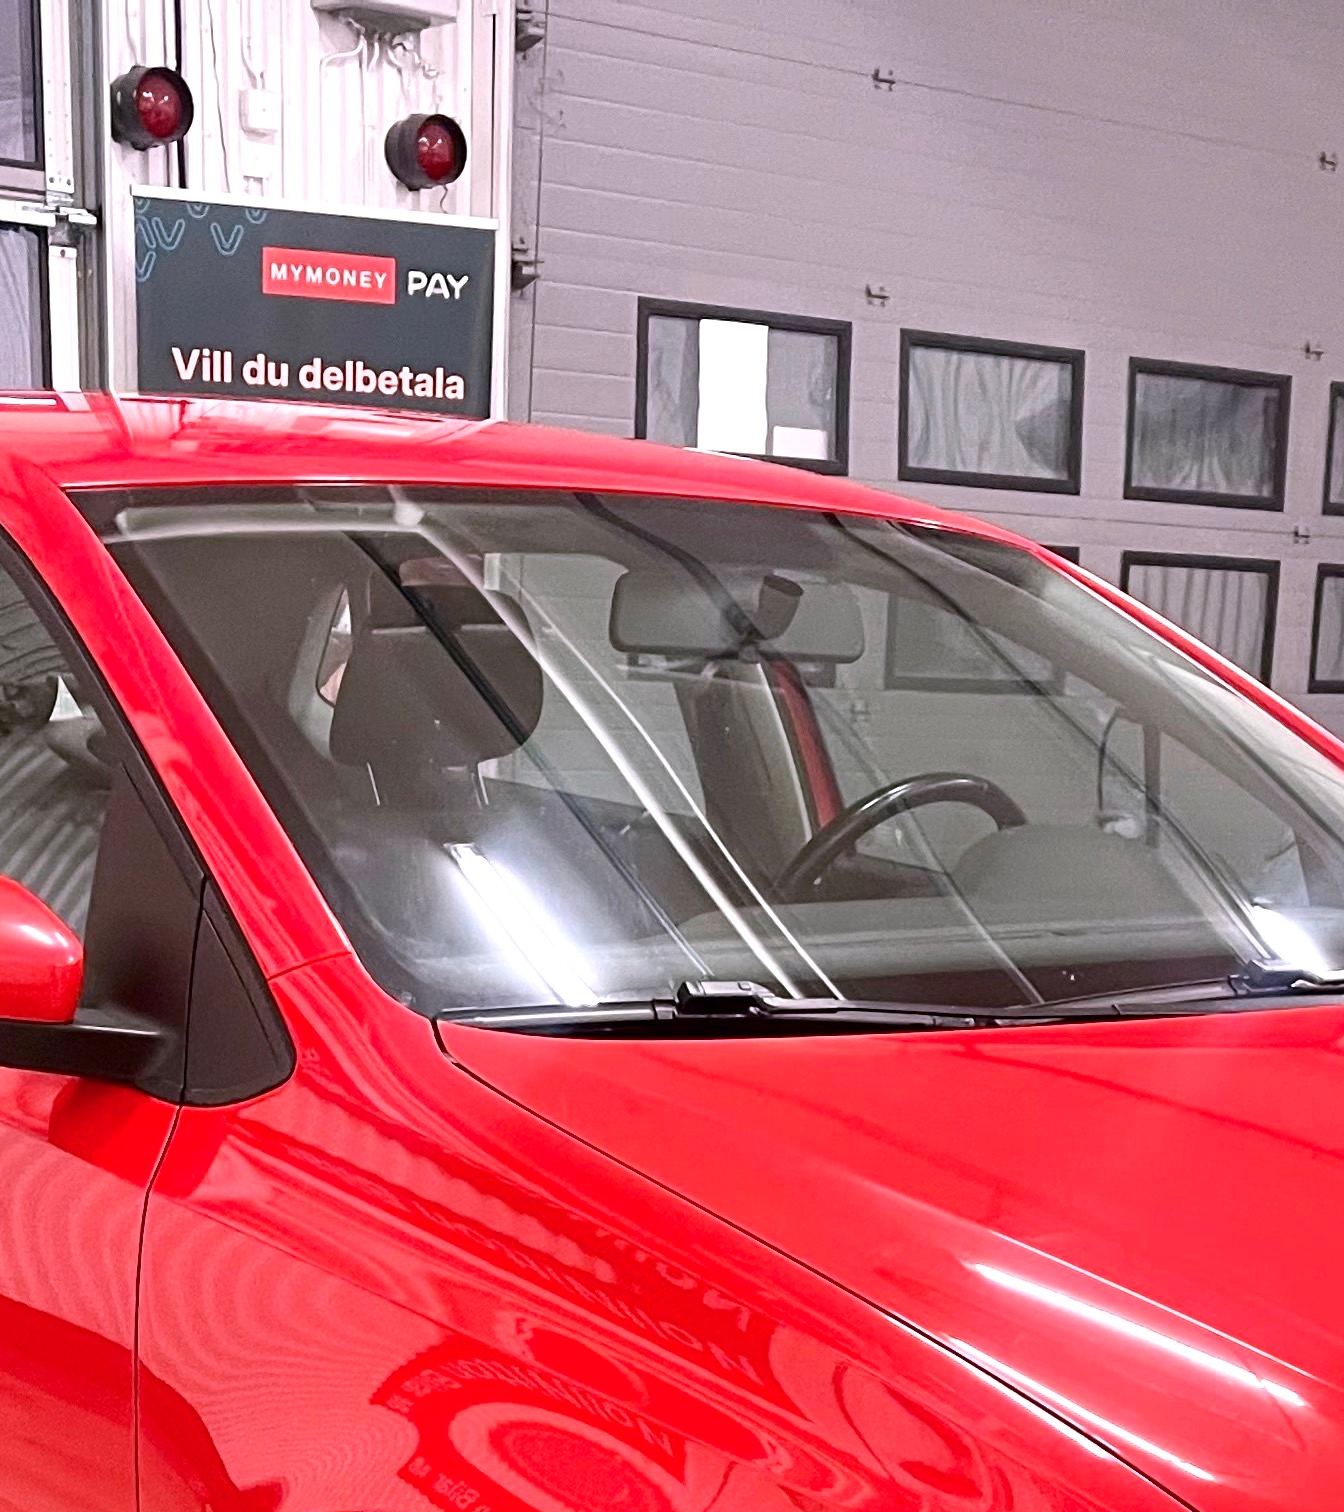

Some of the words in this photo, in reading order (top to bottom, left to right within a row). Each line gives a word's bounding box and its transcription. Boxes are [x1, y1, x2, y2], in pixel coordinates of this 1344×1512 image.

[270, 262, 388, 289] MYMONEY
[407, 270, 469, 299] PAY
[171, 346, 233, 384] Vill
[242, 353, 289, 388] du
[298, 357, 465, 400] delbetala
